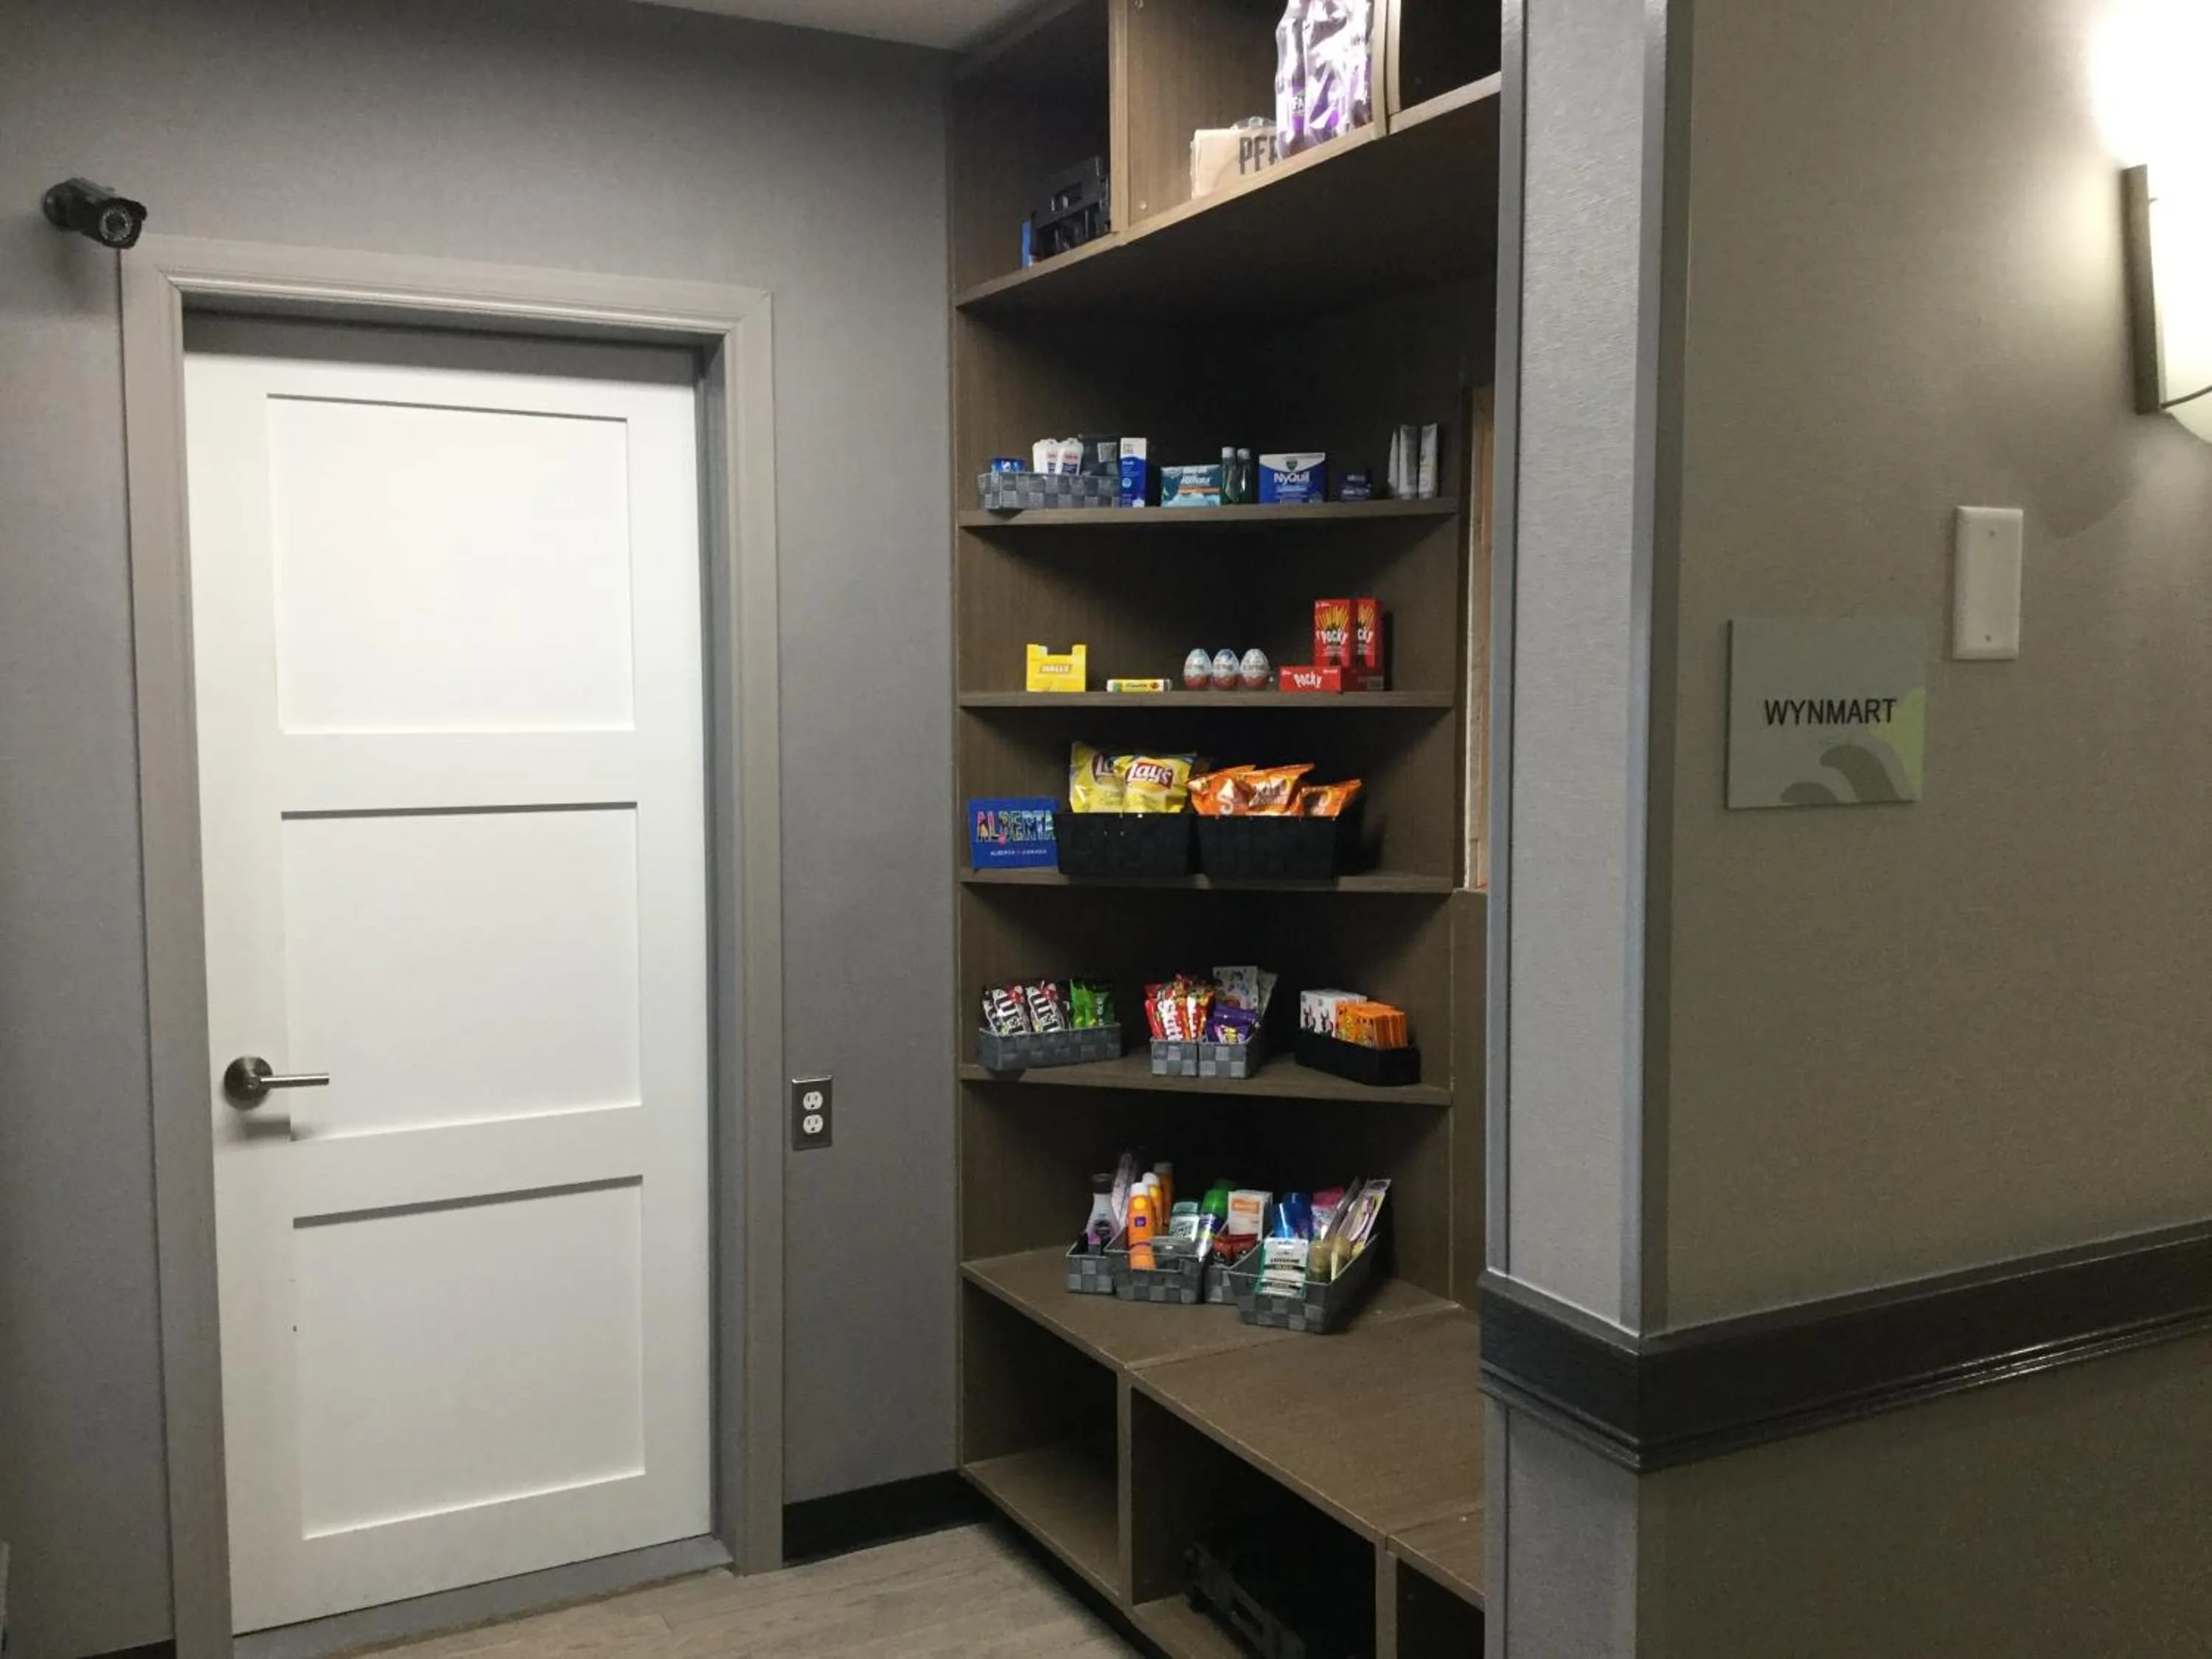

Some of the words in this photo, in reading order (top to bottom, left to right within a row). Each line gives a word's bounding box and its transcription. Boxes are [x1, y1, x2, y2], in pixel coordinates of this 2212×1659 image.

[1273, 470, 1310, 485] NyQuil
[1764, 698, 1897, 726] WYNMART
[976, 809, 1056, 844] ALBERTA
